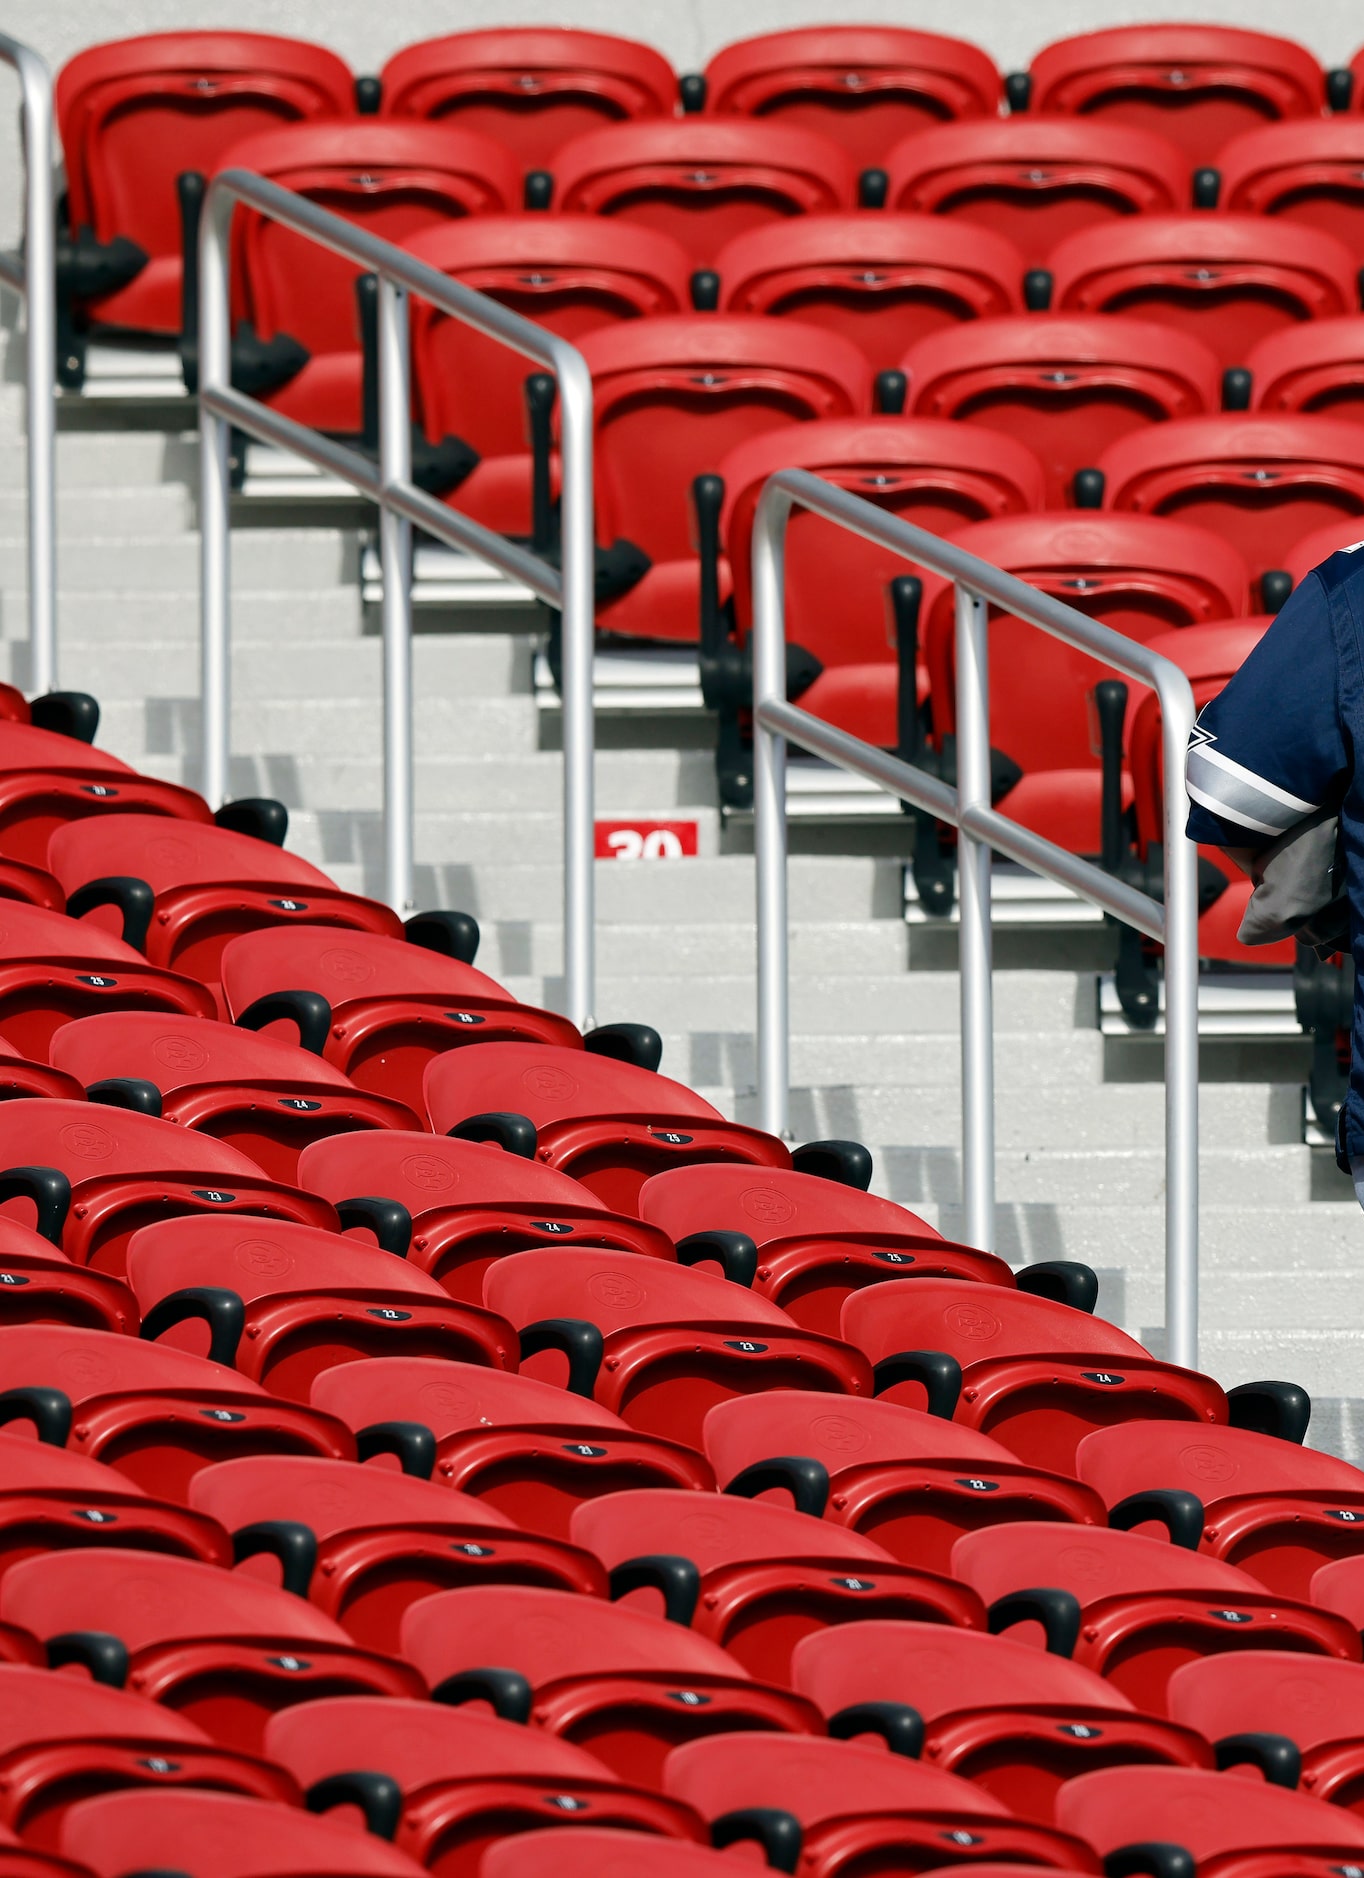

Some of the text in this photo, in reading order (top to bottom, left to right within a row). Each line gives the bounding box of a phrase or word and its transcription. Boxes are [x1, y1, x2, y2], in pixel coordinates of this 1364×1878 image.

[90, 976, 105, 985] 25
[294, 1100, 309, 1109] 24
[667, 1133, 682, 1142] 25
[208, 1191, 222, 1201] 23
[546, 1222, 561, 1232] 24
[887, 1253, 902, 1262] 25
[382, 1309, 399, 1319] 22
[739, 1341, 755, 1351] 23
[1096, 1373, 1112, 1382] 24
[969, 1479, 987, 1489] 22
[1339, 1510, 1355, 1520] 23
